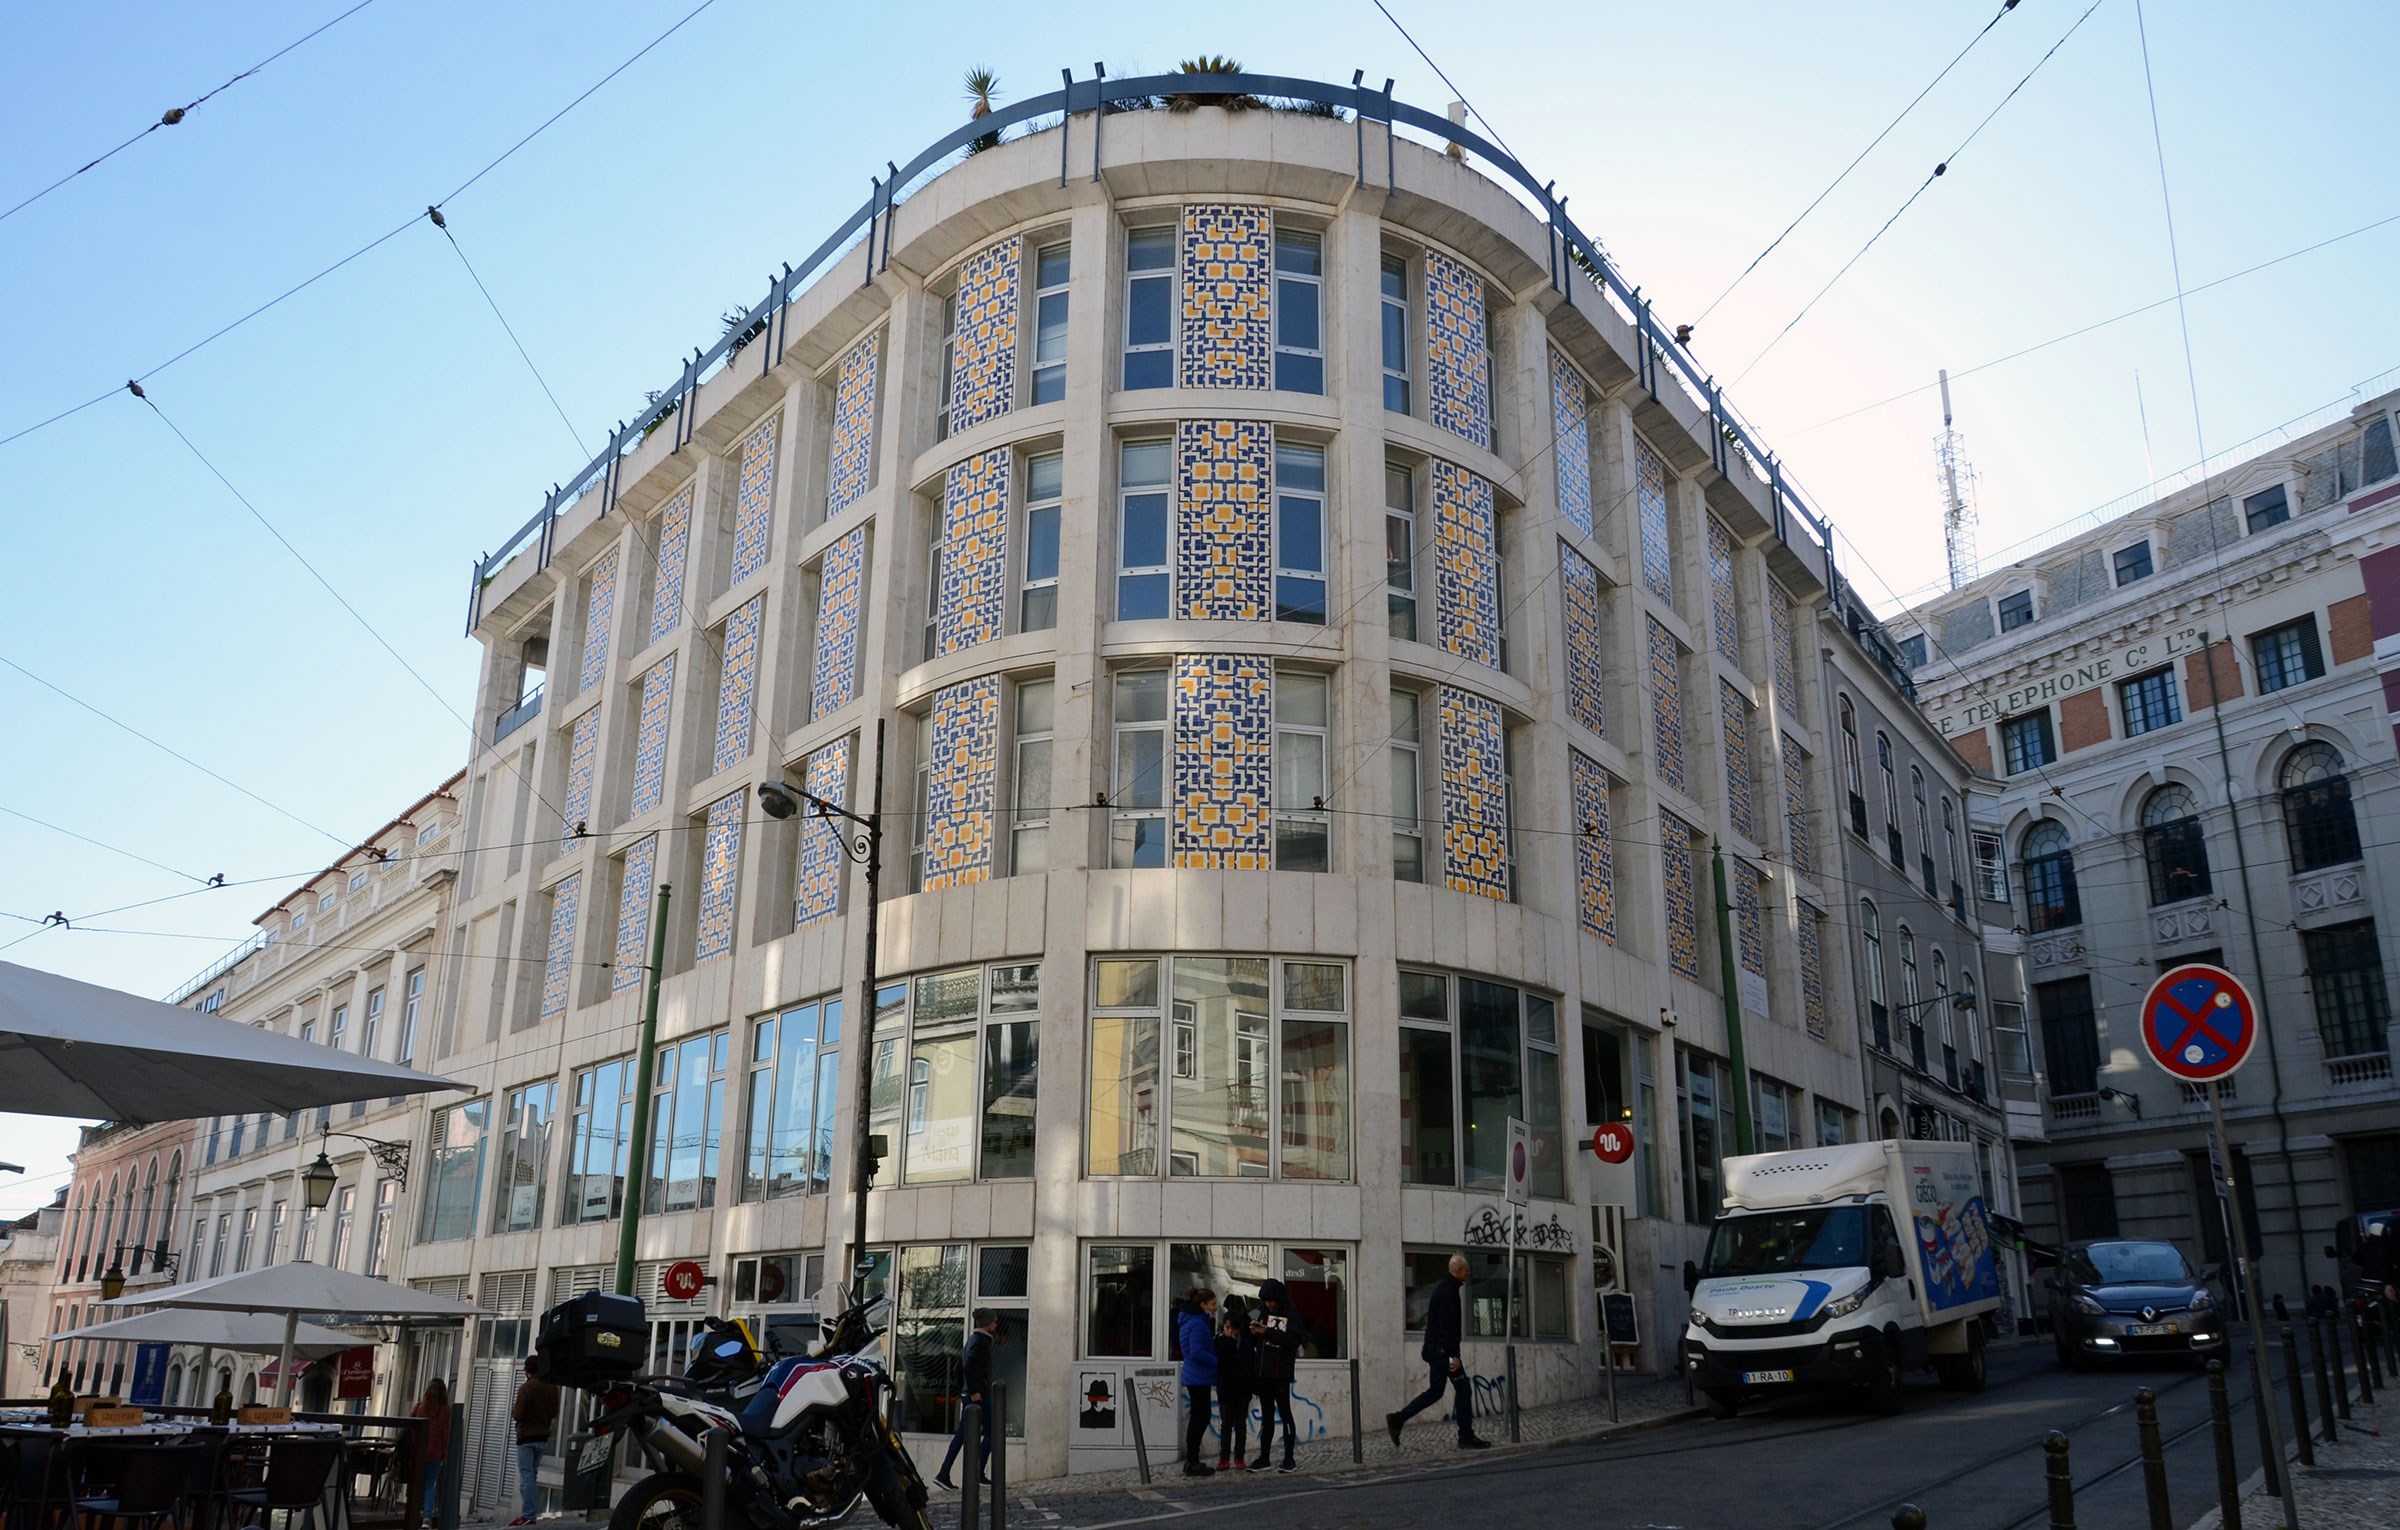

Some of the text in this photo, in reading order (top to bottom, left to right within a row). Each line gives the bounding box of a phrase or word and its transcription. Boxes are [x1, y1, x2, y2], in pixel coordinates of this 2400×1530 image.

[1962, 659, 2112, 725] TELEPHONE
[1709, 1283, 1776, 1294] Paulo Duarte
[1738, 1307, 1786, 1320] IVECO
